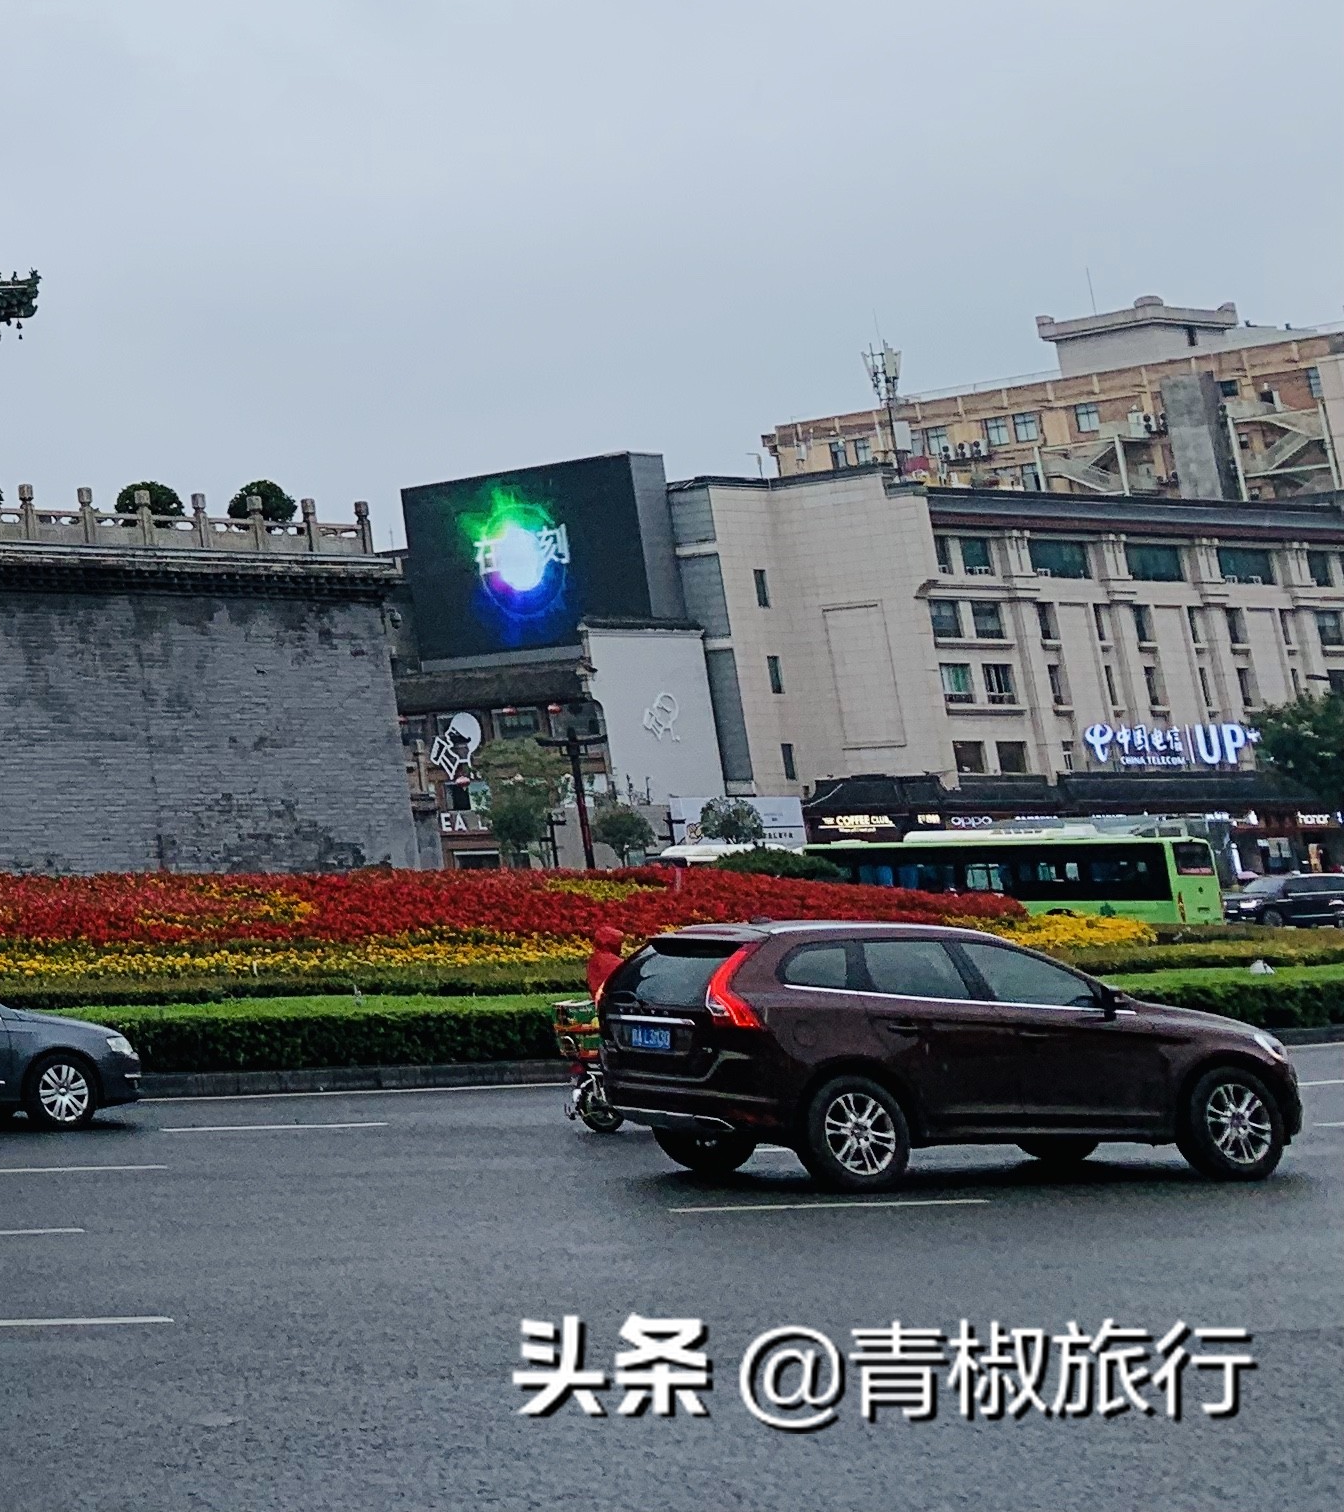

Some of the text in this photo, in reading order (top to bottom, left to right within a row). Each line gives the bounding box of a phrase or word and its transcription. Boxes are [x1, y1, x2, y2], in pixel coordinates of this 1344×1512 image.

[1116, 724, 1184, 755] 中国电信
[1120, 755, 1187, 766] CHINA TELECOM
[835, 814, 870, 826] COFFEE
[1297, 810, 1330, 825] honor
